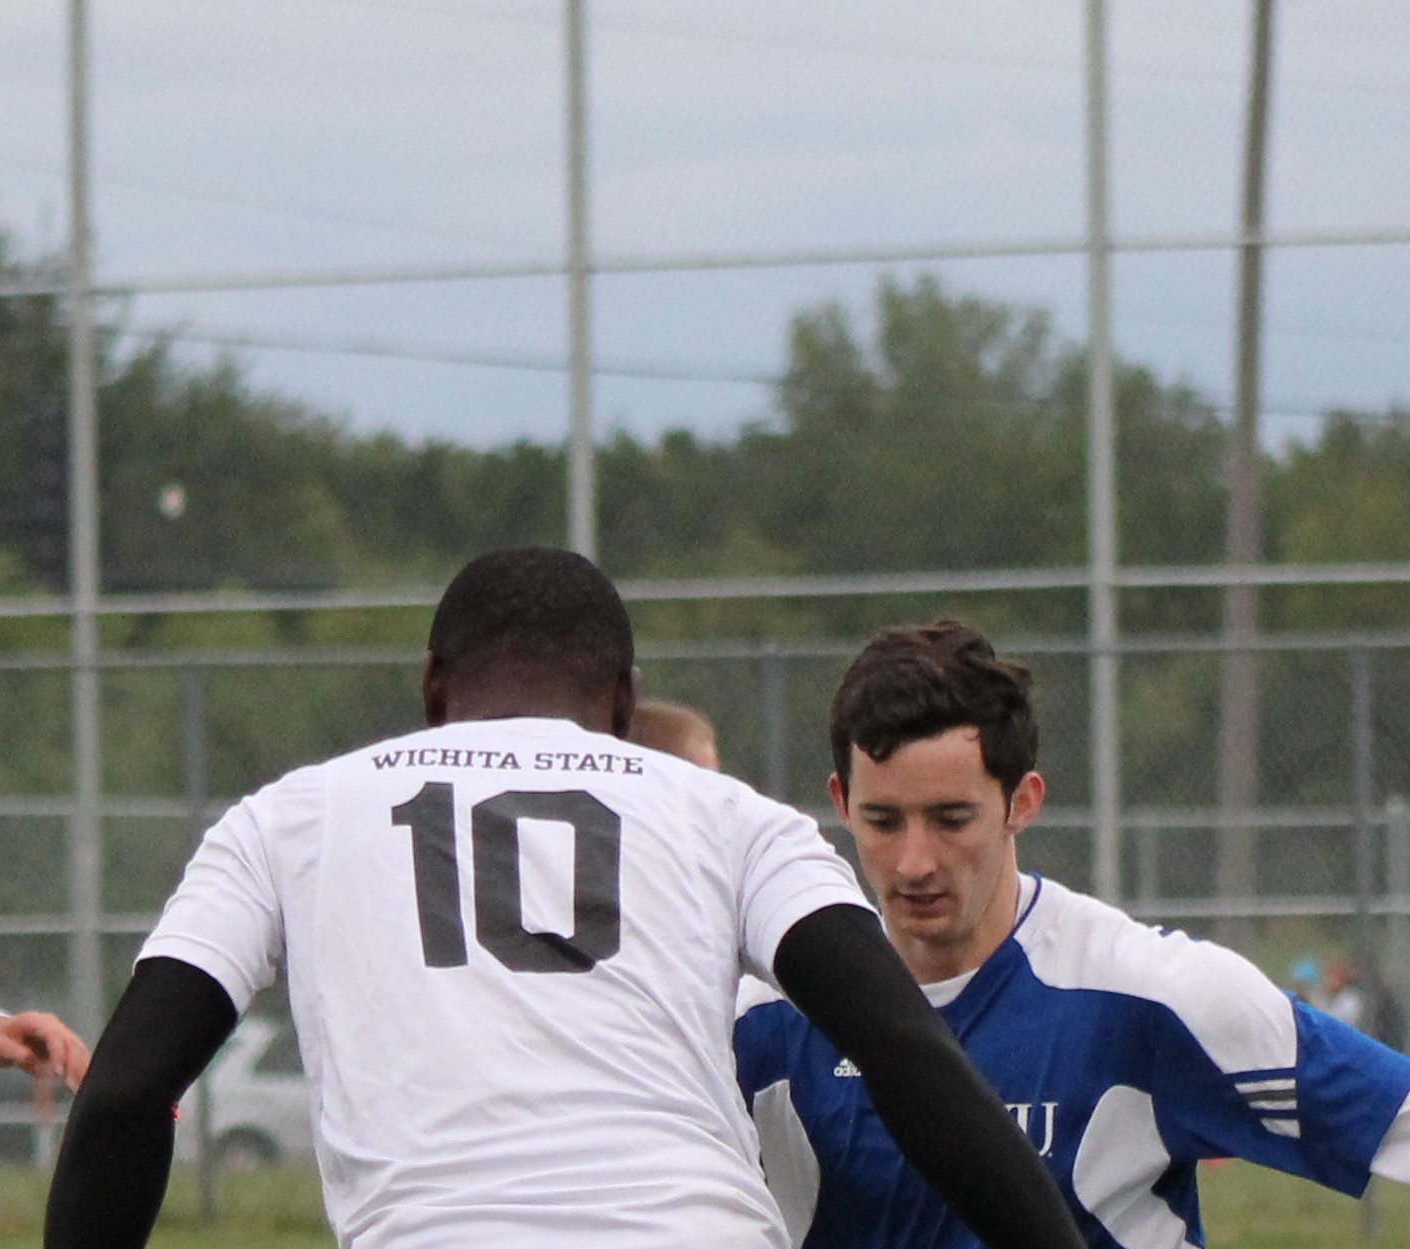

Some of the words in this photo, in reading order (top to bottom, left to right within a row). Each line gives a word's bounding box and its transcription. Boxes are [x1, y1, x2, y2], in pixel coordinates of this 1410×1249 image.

[372, 748, 521, 771] WICHITA
[534, 752, 644, 776] STATE
[391, 781, 622, 973] 10
